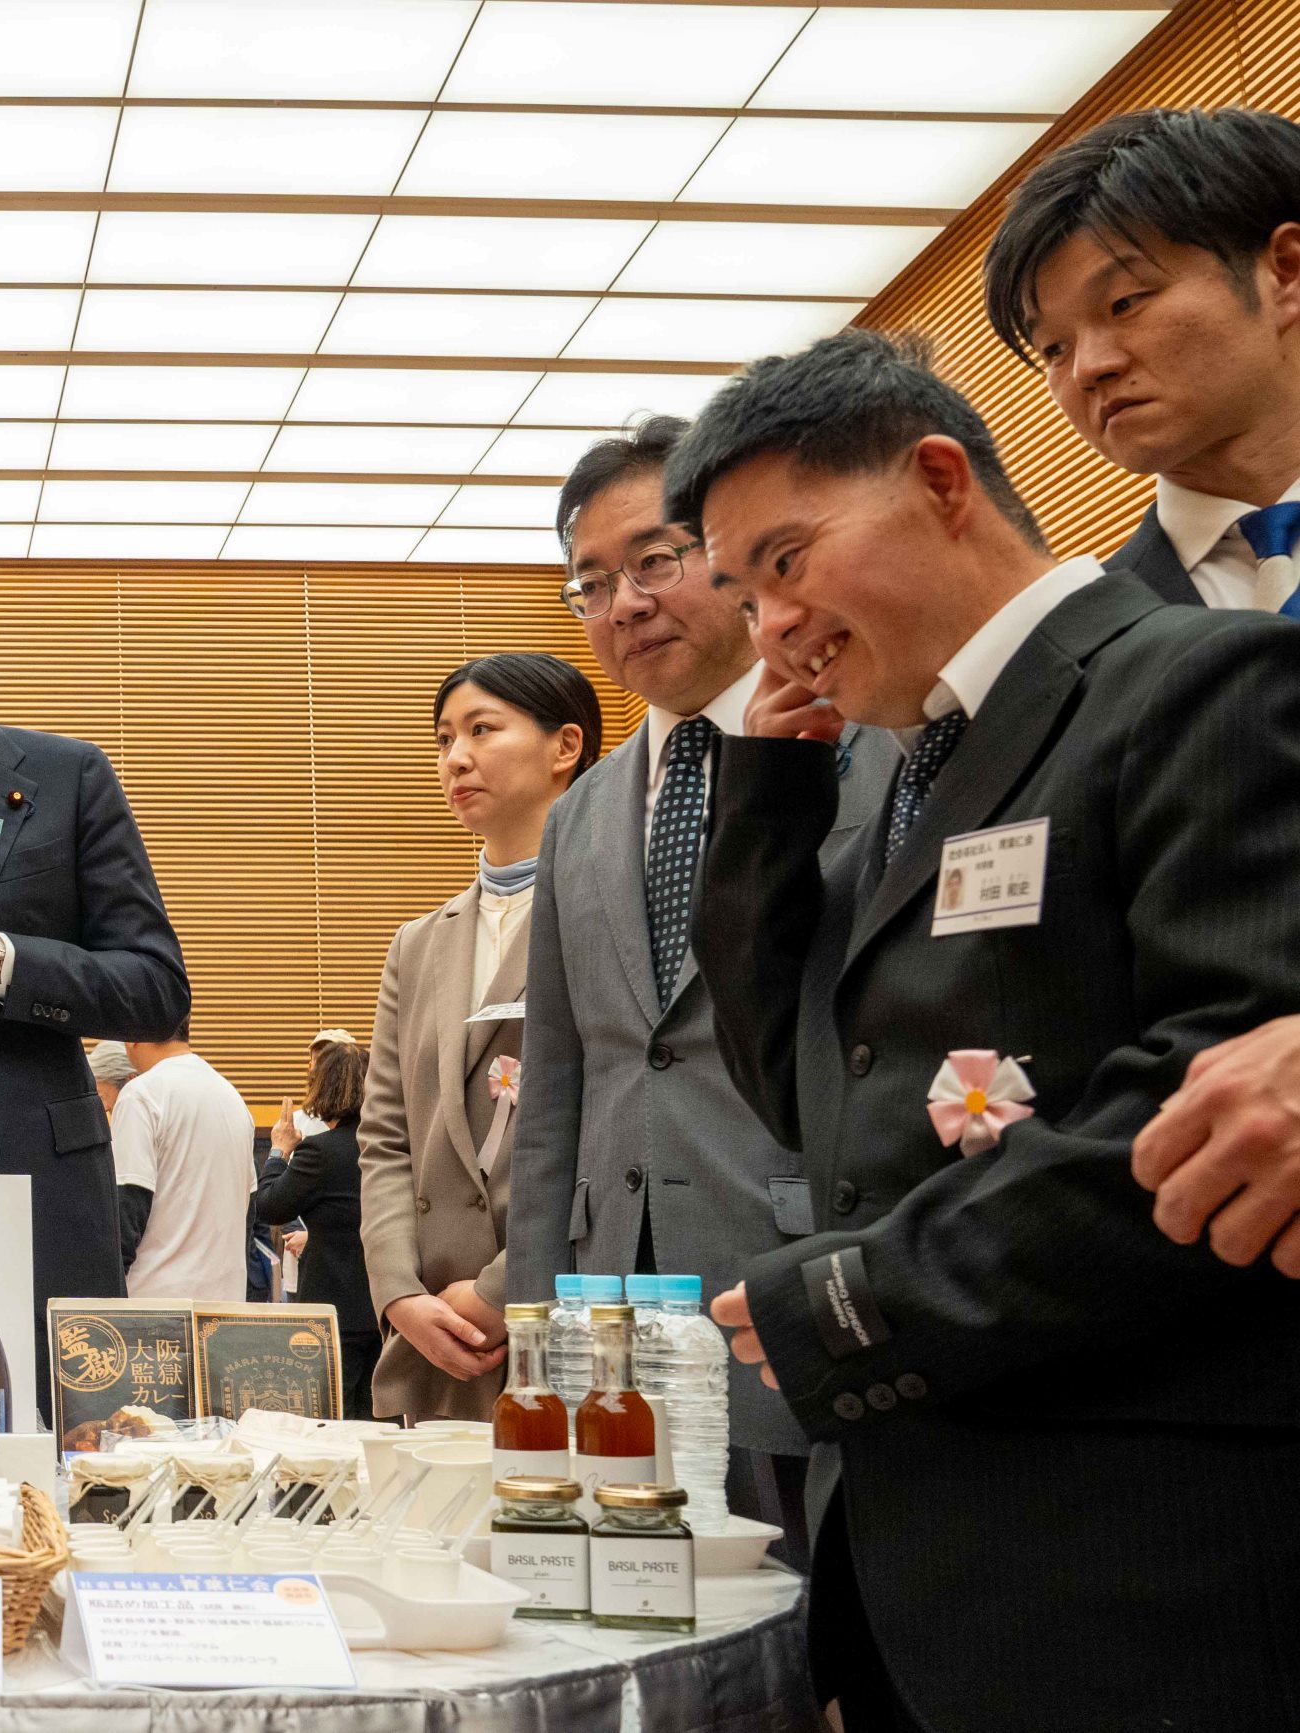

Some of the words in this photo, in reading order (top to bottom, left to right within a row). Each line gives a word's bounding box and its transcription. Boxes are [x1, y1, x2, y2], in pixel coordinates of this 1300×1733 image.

[128, 1338, 182, 1363] 大阪
[130, 1363, 184, 1386] 監獄
[224, 1355, 259, 1375] NARA
[263, 1354, 314, 1375] PRISON
[131, 1386, 186, 1405] カレー
[507, 1554, 538, 1566] BASIL
[540, 1555, 576, 1567] PASTE
[608, 1560, 640, 1572] BASIL
[642, 1561, 679, 1574] PASTE
